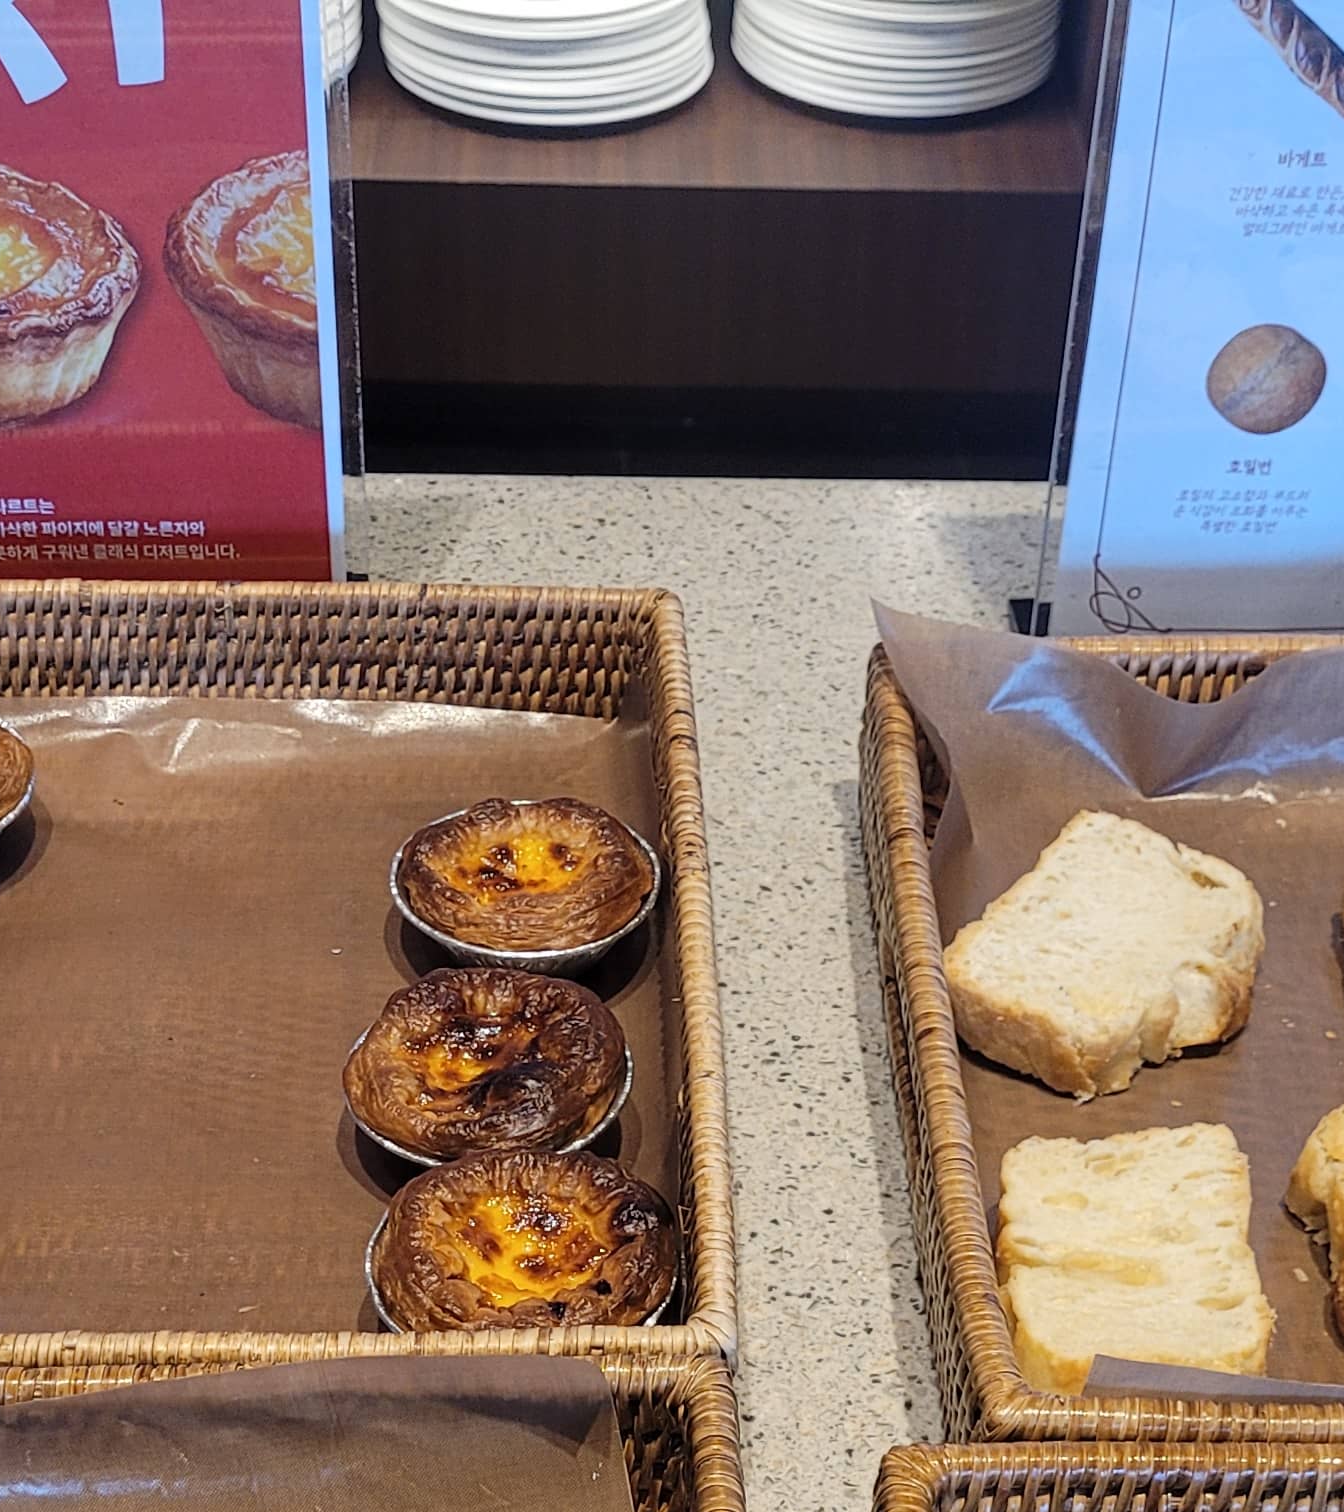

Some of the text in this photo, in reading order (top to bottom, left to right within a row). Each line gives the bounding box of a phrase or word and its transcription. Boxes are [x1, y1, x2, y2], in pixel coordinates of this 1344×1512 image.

[1277, 148, 1328, 168] 바게트
[1225, 458, 1272, 476] 호밀번
[41, 520, 104, 538] 파이지에
[108, 520, 139, 537] 달걀
[143, 520, 205, 537] 노른자와
[42, 544, 89, 560] 구워낸
[93, 543, 139, 560] 클래식
[143, 543, 240, 560] 디저트입니다.
